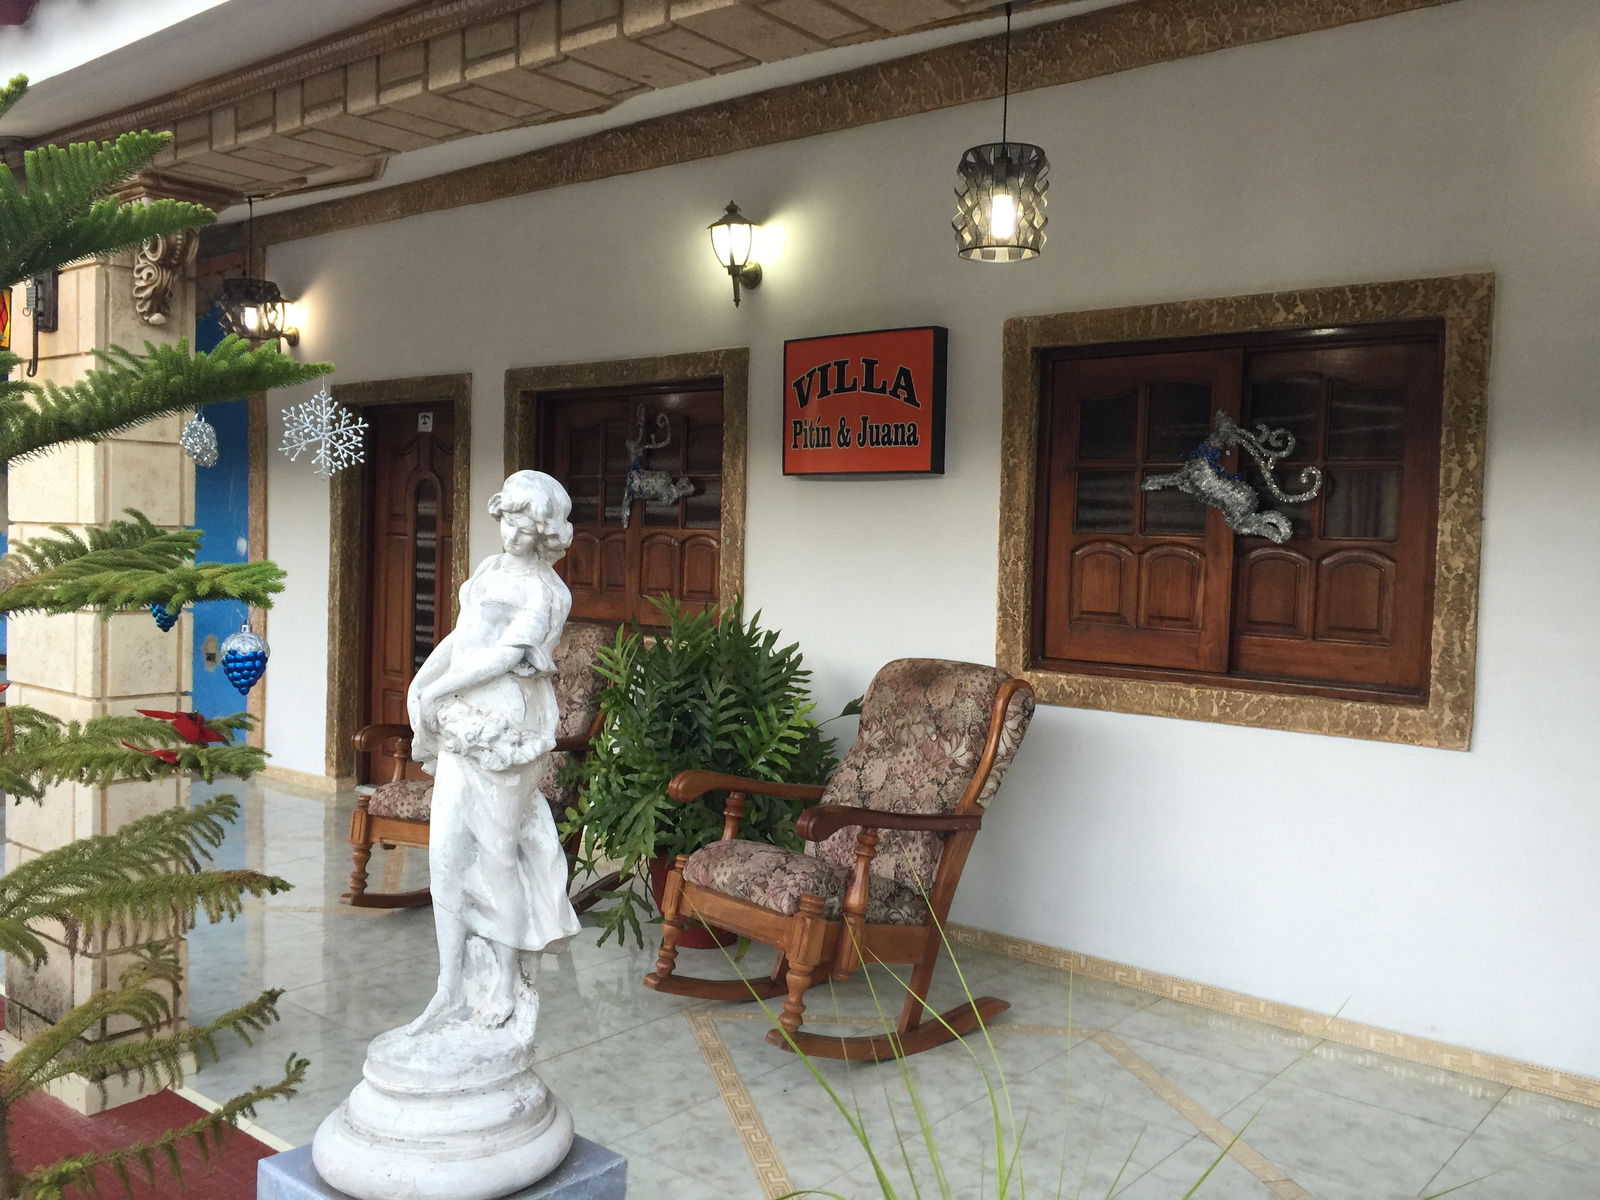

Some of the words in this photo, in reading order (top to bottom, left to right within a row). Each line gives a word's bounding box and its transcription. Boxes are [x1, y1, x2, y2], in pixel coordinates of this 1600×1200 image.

[792, 357, 921, 409] VILLA
[792, 416, 831, 449] Pitín
[837, 416, 851, 448] &
[857, 416, 919, 447] Juana
